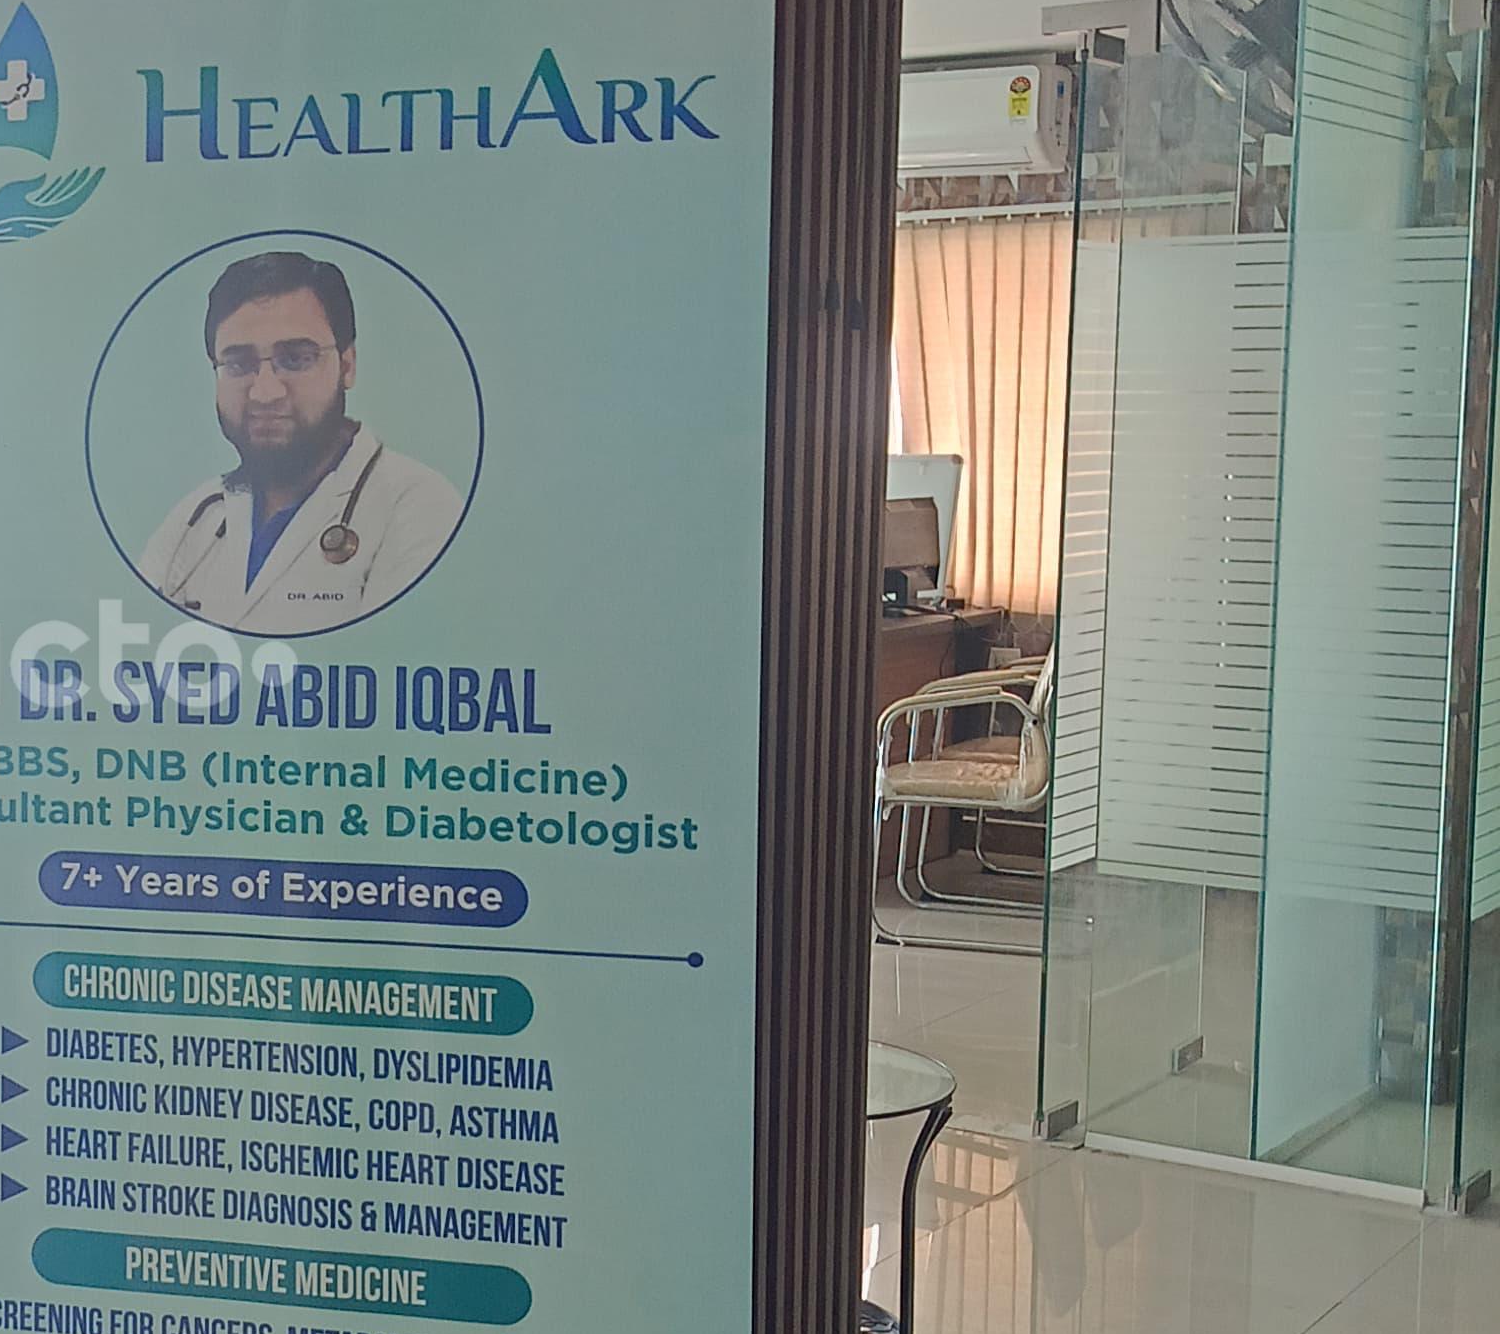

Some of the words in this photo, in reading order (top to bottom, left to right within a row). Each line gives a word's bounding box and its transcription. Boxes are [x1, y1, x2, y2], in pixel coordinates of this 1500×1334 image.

[18, 657, 97, 724] DR.
[112, 659, 241, 726] SYED
[255, 663, 377, 730] ABID
[395, 665, 552, 736] IQBAL
[96, 747, 187, 782] DNB
[202, 750, 386, 789] (Internal
[403, 756, 628, 803] Medicine)
[126, 795, 324, 837] Physician
[339, 803, 370, 837] &
[385, 804, 699, 855] Diabetologist
[61, 862, 103, 890] 7+
[115, 864, 219, 897] Years
[231, 869, 270, 900] of
[283, 872, 503, 911] Experience
[64, 964, 175, 1003] CHRONIC
[183, 970, 293, 1011] DISEASE
[301, 977, 498, 1023] MANAGEMENT
[46, 1026, 165, 1070] DIABETES,
[172, 1034, 366, 1083] HYPERTENSION,
[373, 1047, 554, 1092] DYSLIPIDEMIA
[46, 1075, 147, 1114] CHRONIC
[154, 1083, 244, 1120] KIDNEY
[250, 1090, 361, 1134] DISEASE,
[368, 1098, 442, 1140] COPD,
[449, 1104, 560, 1145] ASTHMA
[46, 1125, 122, 1162] HEART
[128, 1131, 233, 1174] FAILURE,
[240, 1139, 360, 1180] ISCHEMIC
[366, 1149, 451, 1187] HEART
[457, 1156, 565, 1197] DISEASE
[45, 1174, 116, 1211] BRAIN
[122, 1181, 216, 1219] STROKE
[222, 1188, 353, 1231] DIAGNOSIS
[360, 1200, 378, 1232] &
[384, 1201, 568, 1249] MANAGEMENT
[126, 1246, 287, 1294] PREVENTIVE
[295, 1261, 427, 1306] MEDICINE
